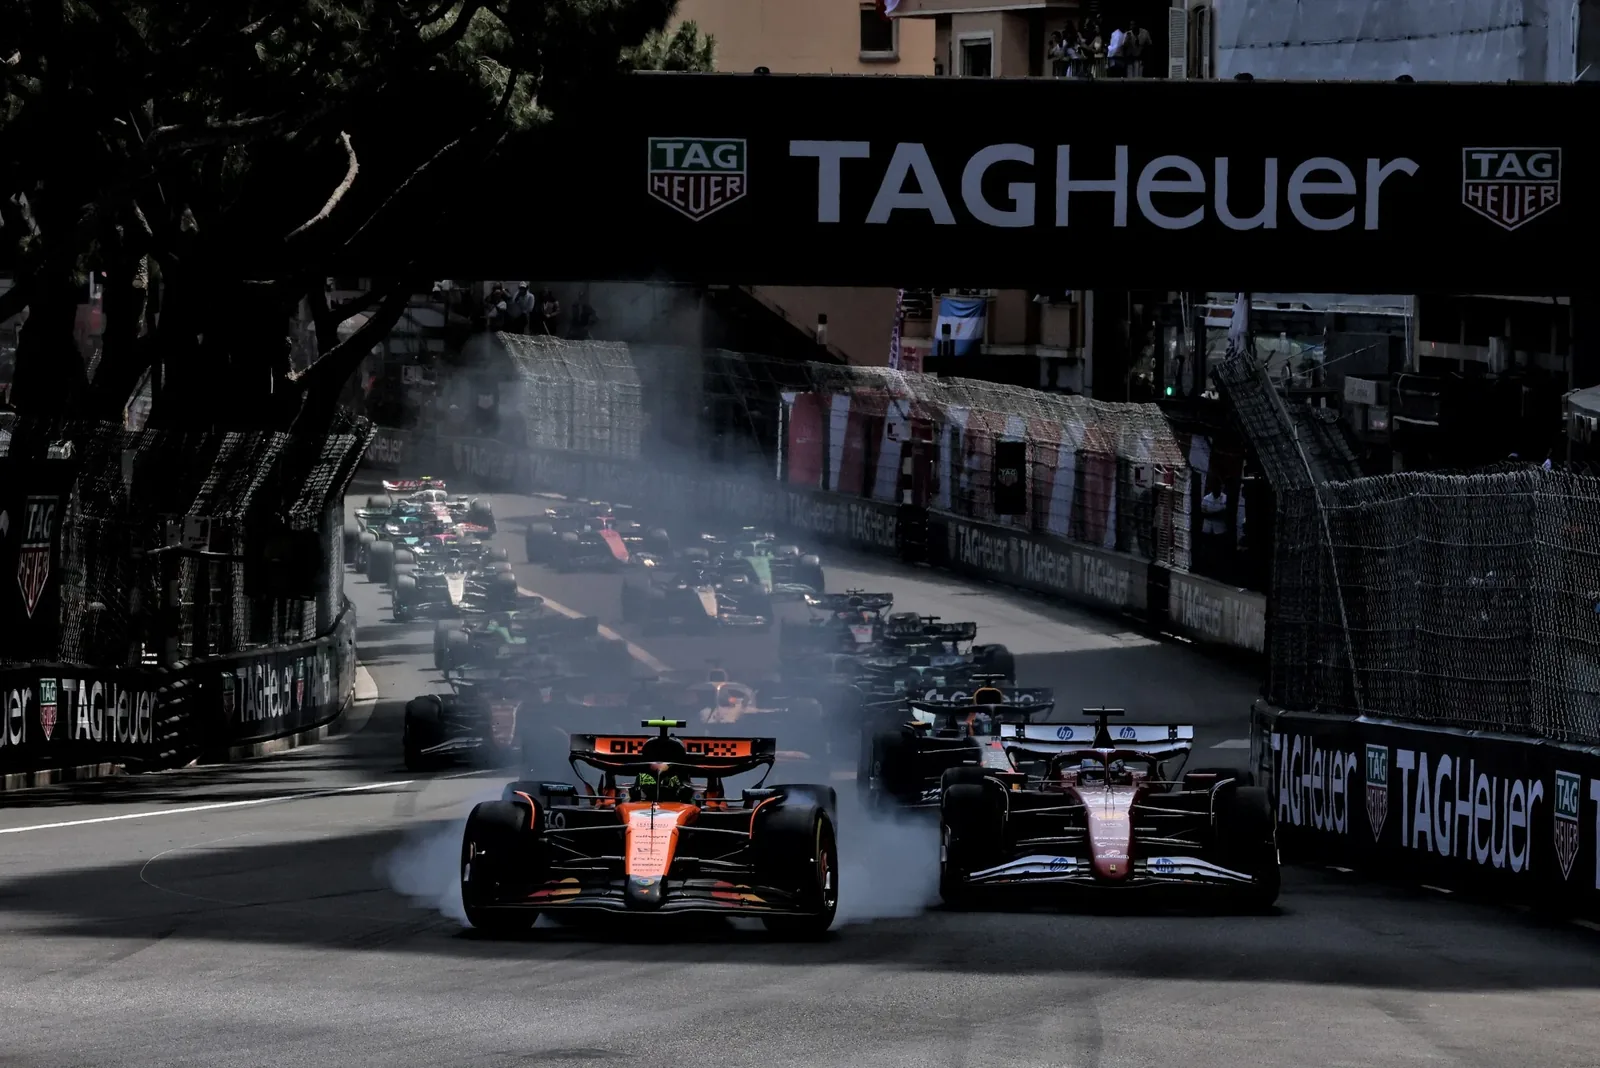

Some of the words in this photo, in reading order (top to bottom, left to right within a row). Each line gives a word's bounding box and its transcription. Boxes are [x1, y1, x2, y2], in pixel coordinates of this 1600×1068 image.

[657, 142, 738, 169] TAG
[1471, 152, 1553, 178] TAG
[653, 174, 742, 215] HEUER
[1468, 185, 1556, 225] HEUER
[27, 503, 54, 540] TAG
[40, 682, 57, 701] TAG
[1367, 751, 1387, 781] TAG
[1557, 778, 1578, 813] TAG
